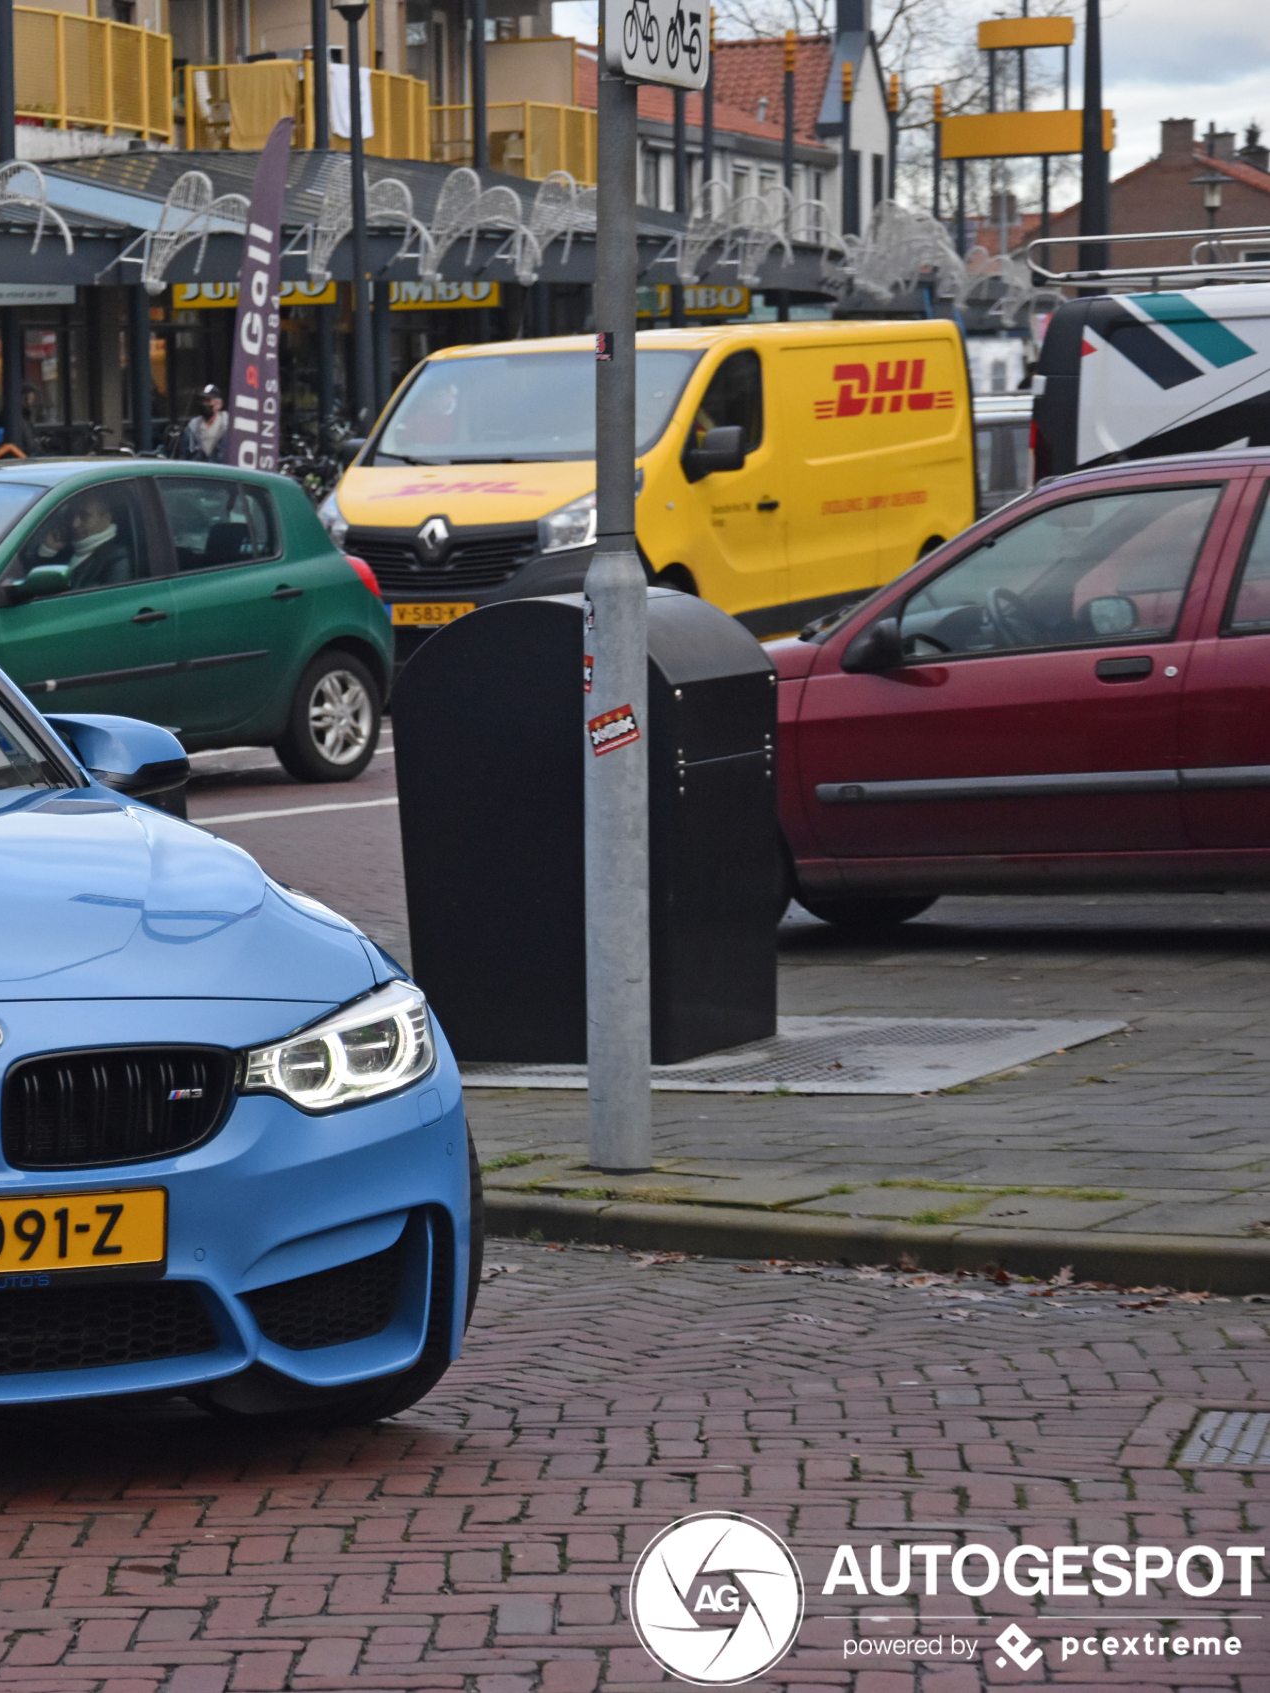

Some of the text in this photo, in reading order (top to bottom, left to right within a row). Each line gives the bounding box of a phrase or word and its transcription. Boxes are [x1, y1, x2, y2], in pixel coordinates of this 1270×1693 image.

[236, 222, 274, 470] all&Gall
[259, 380, 278, 469] SINDS
[832, 359, 935, 418] DHL
[394, 482, 522, 496] DHL
